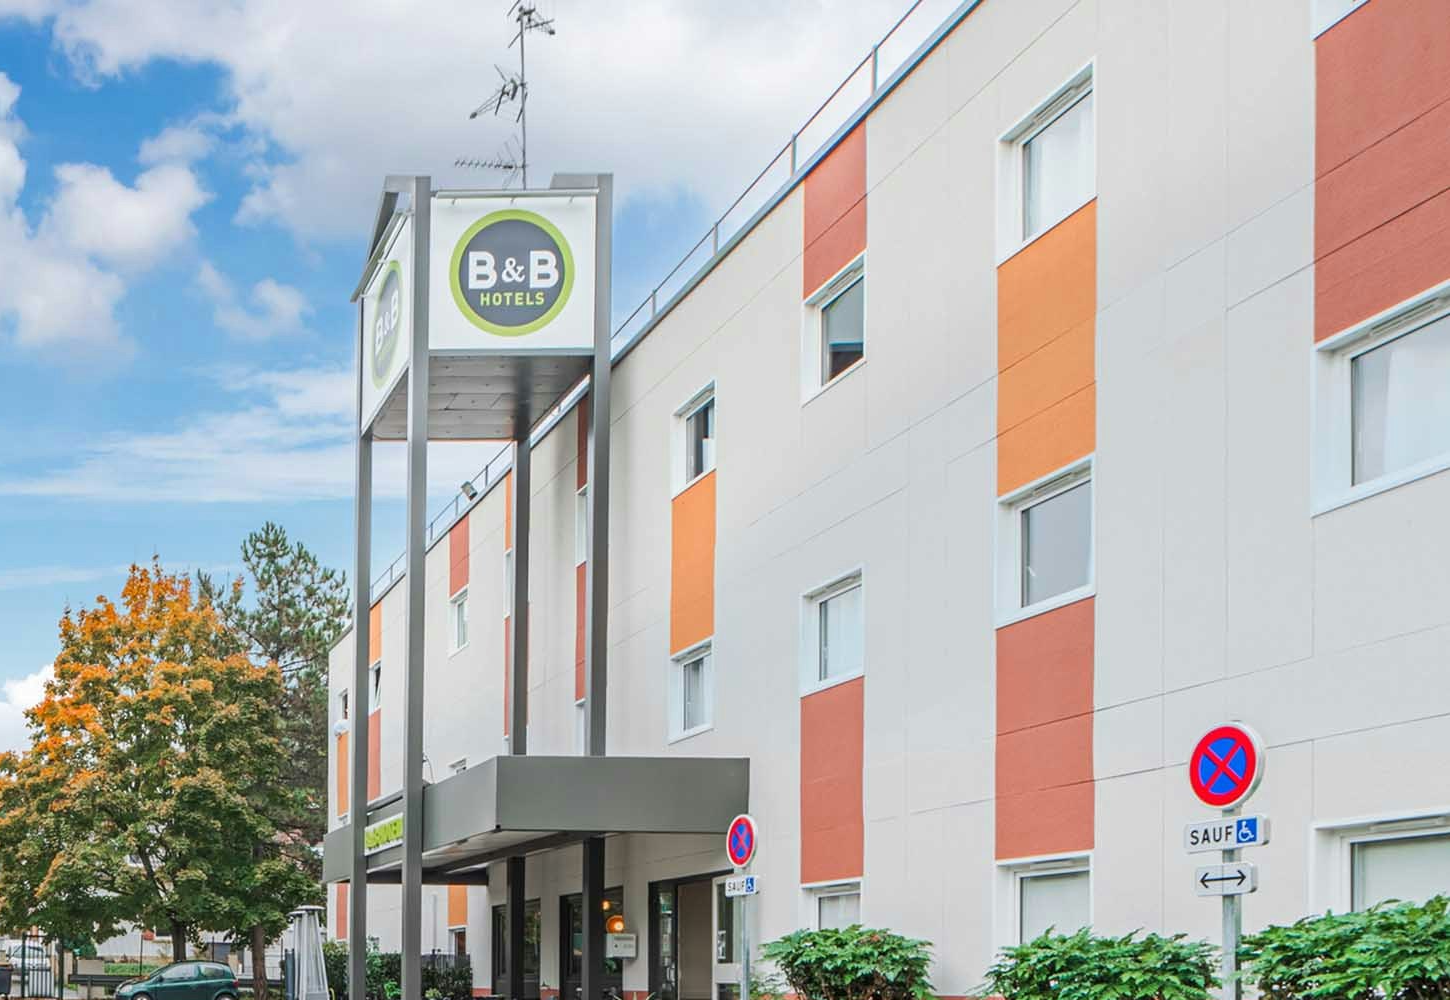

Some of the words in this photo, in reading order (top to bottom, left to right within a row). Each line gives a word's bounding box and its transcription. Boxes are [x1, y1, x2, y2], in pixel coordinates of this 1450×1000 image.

[469, 251, 559, 289] B&B
[480, 292, 545, 306] HOTELS
[1190, 826, 1234, 845] SAUF
